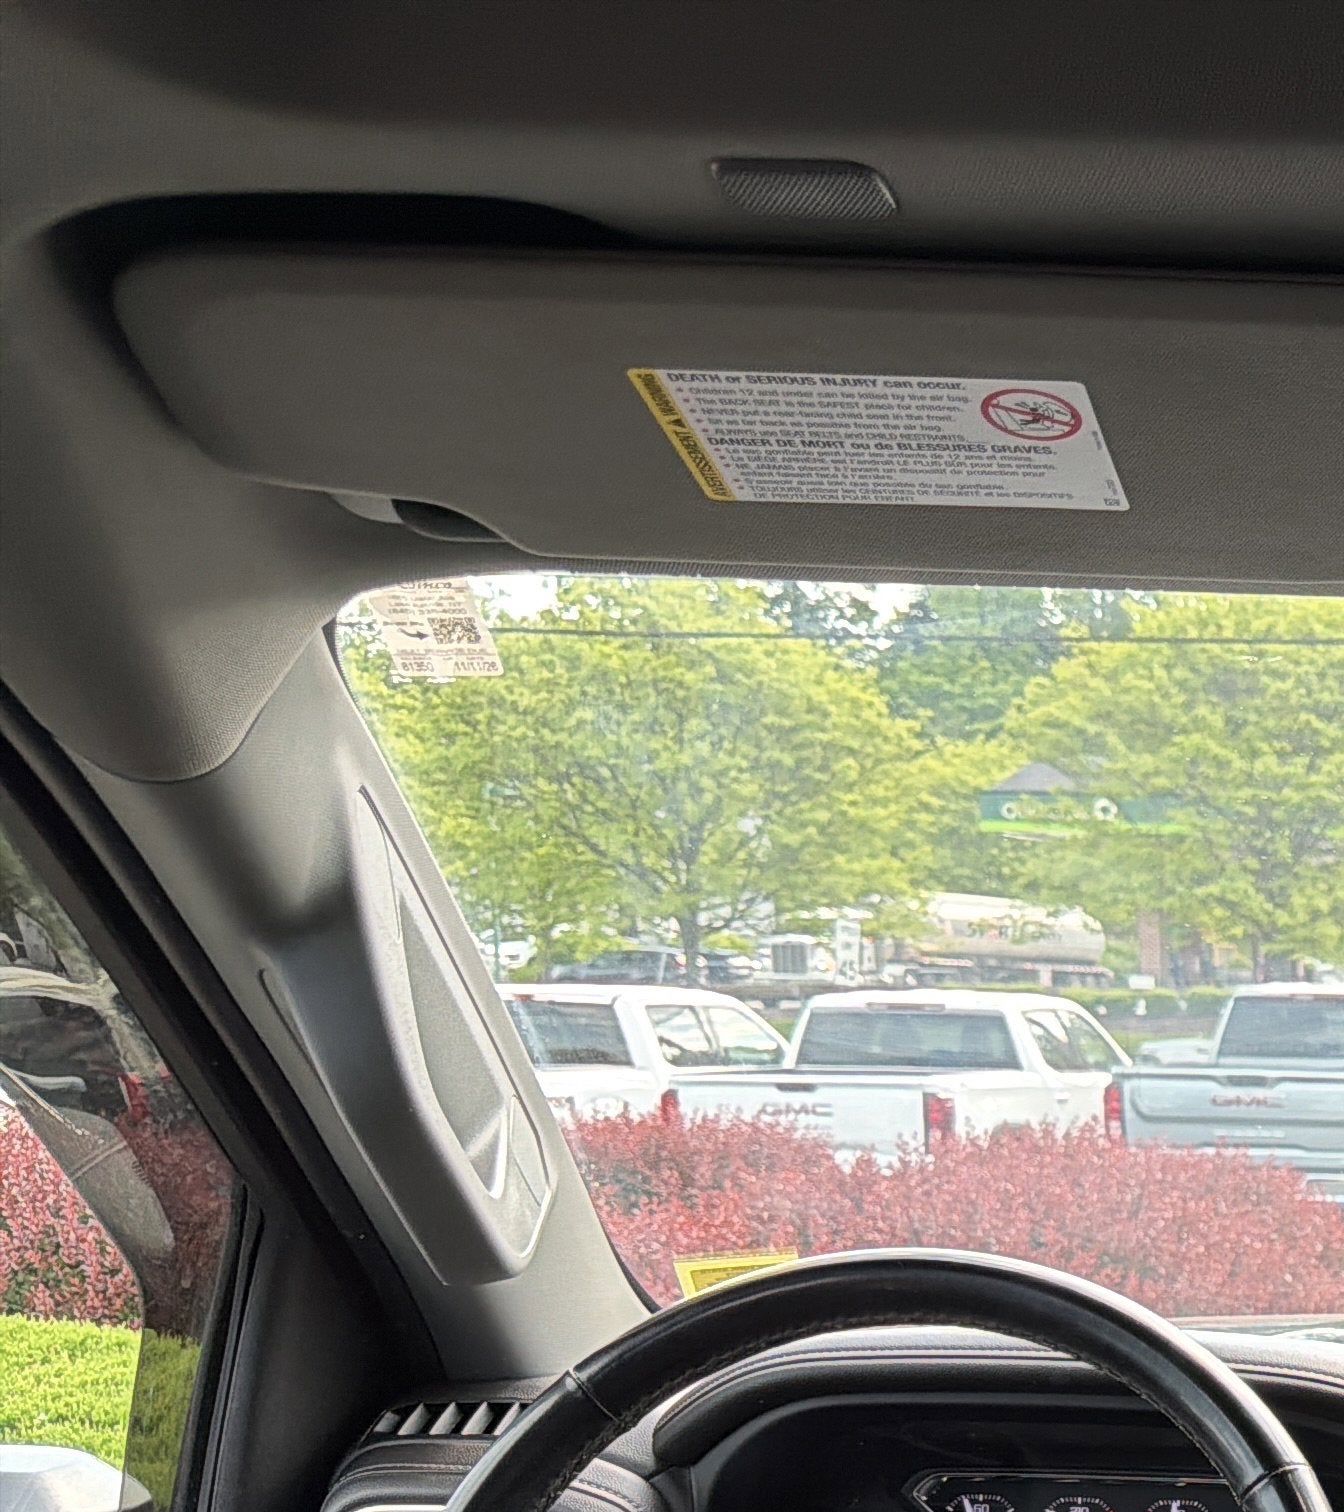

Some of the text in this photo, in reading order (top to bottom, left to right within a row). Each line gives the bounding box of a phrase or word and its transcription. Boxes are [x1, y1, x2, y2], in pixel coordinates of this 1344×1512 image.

[665, 372, 966, 390] DEATH or SERIOUS INJURY can occur.
[636, 373, 679, 416] WARNING
[706, 436, 1057, 455] DANGER DE MORT ou de BLESSURES GRAVES.
